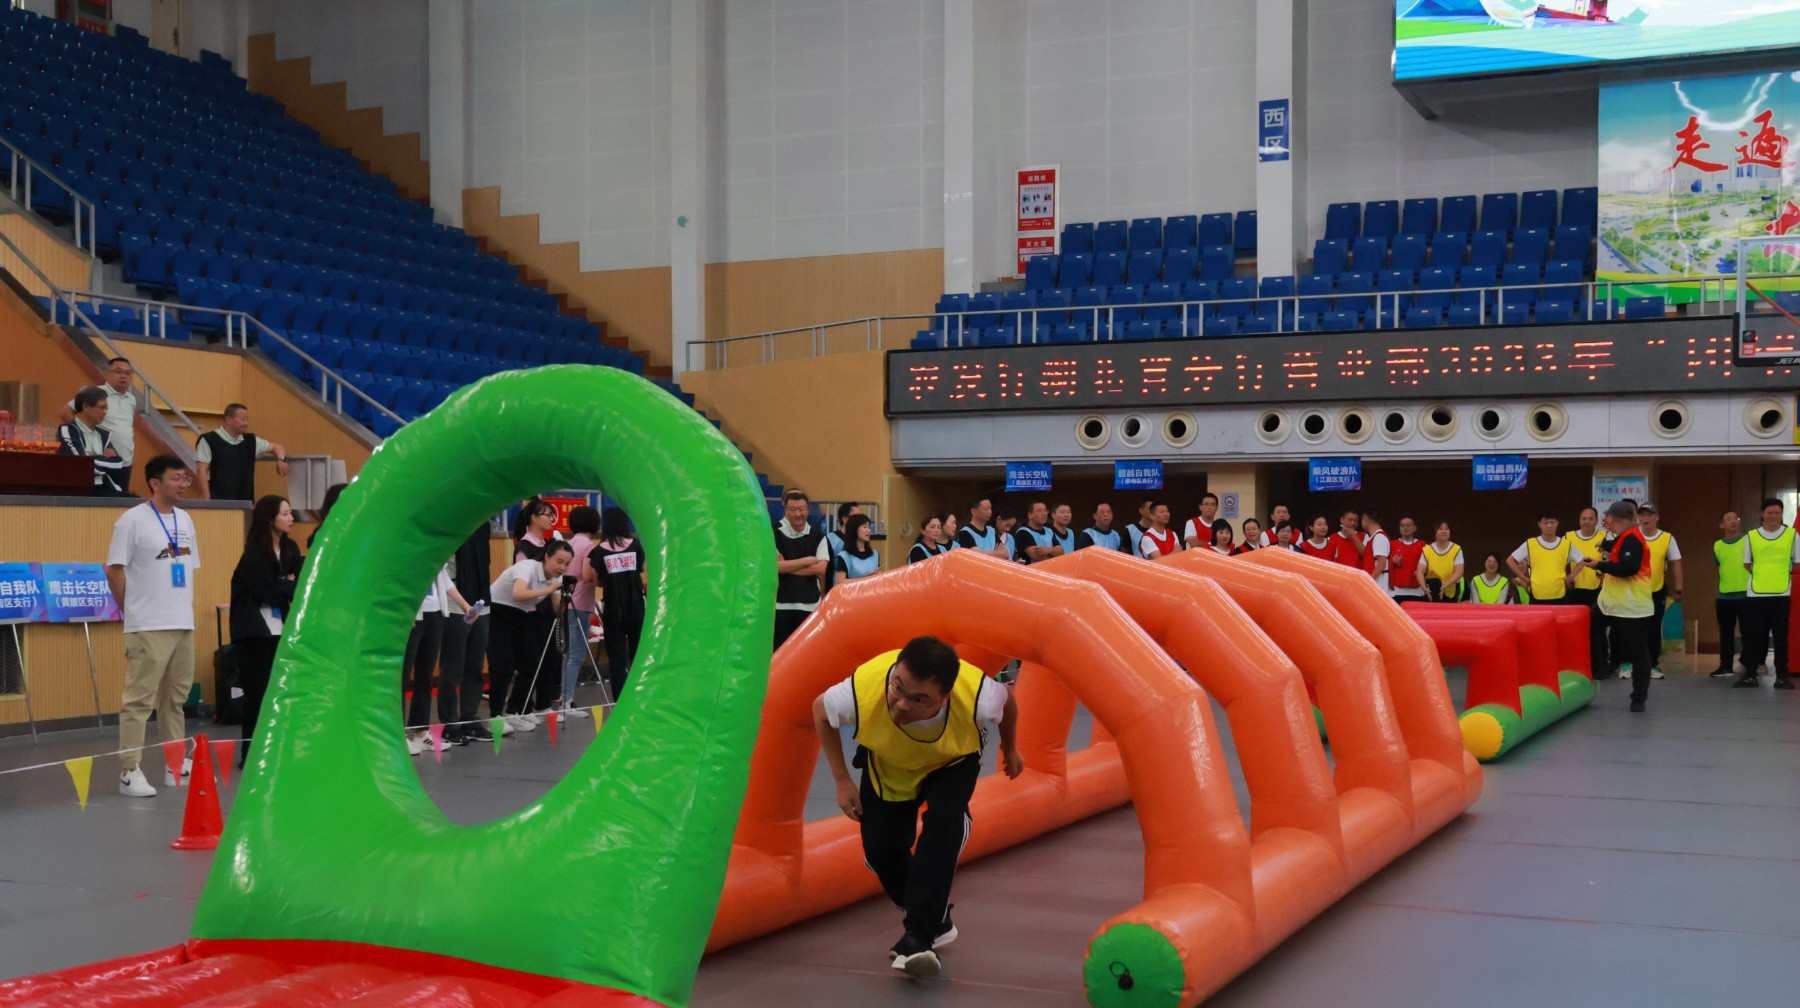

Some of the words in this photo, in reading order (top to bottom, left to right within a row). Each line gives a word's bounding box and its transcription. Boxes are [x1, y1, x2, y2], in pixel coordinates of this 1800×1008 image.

[1263, 108, 1285, 155] 西区
[1664, 109, 1796, 172] 走遍
[1009, 470, 1049, 479] 鹰击长空队
[1118, 468, 1161, 477] 超越自我队
[1312, 466, 1358, 476] 乘风破浪队
[0, 579, 40, 596] 自我队
[49, 579, 111, 596] 鹰击长空队
